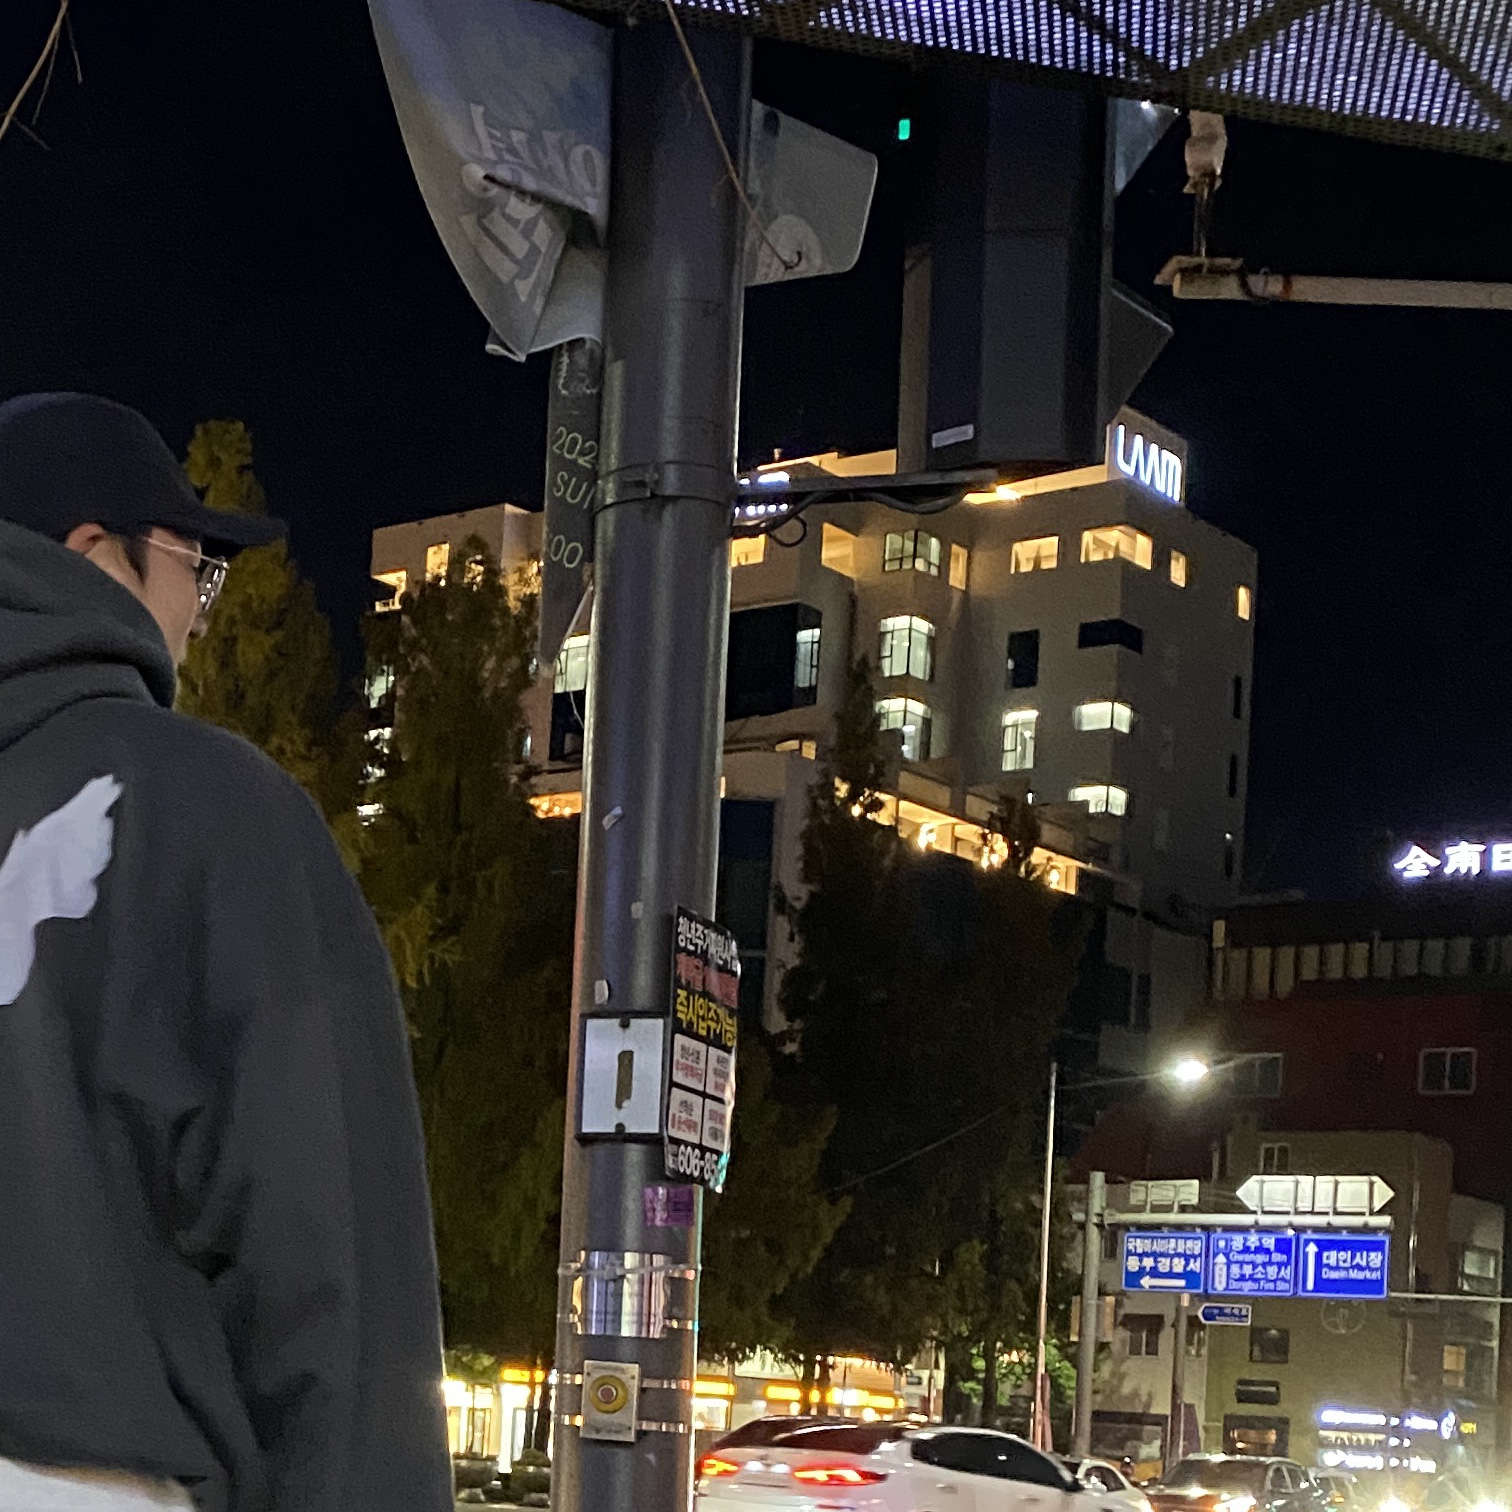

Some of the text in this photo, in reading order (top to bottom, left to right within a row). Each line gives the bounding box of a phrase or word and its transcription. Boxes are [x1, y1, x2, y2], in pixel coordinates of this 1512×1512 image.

[552, 426, 599, 469] 202
[678, 1144, 719, 1182] 606-85
[1230, 1234, 1276, 1252] 광주역
[1126, 1255, 1201, 1273] 동부경찰서
[1322, 1250, 1383, 1268] 대인시장
[1229, 1263, 1291, 1280] 동부소방서
